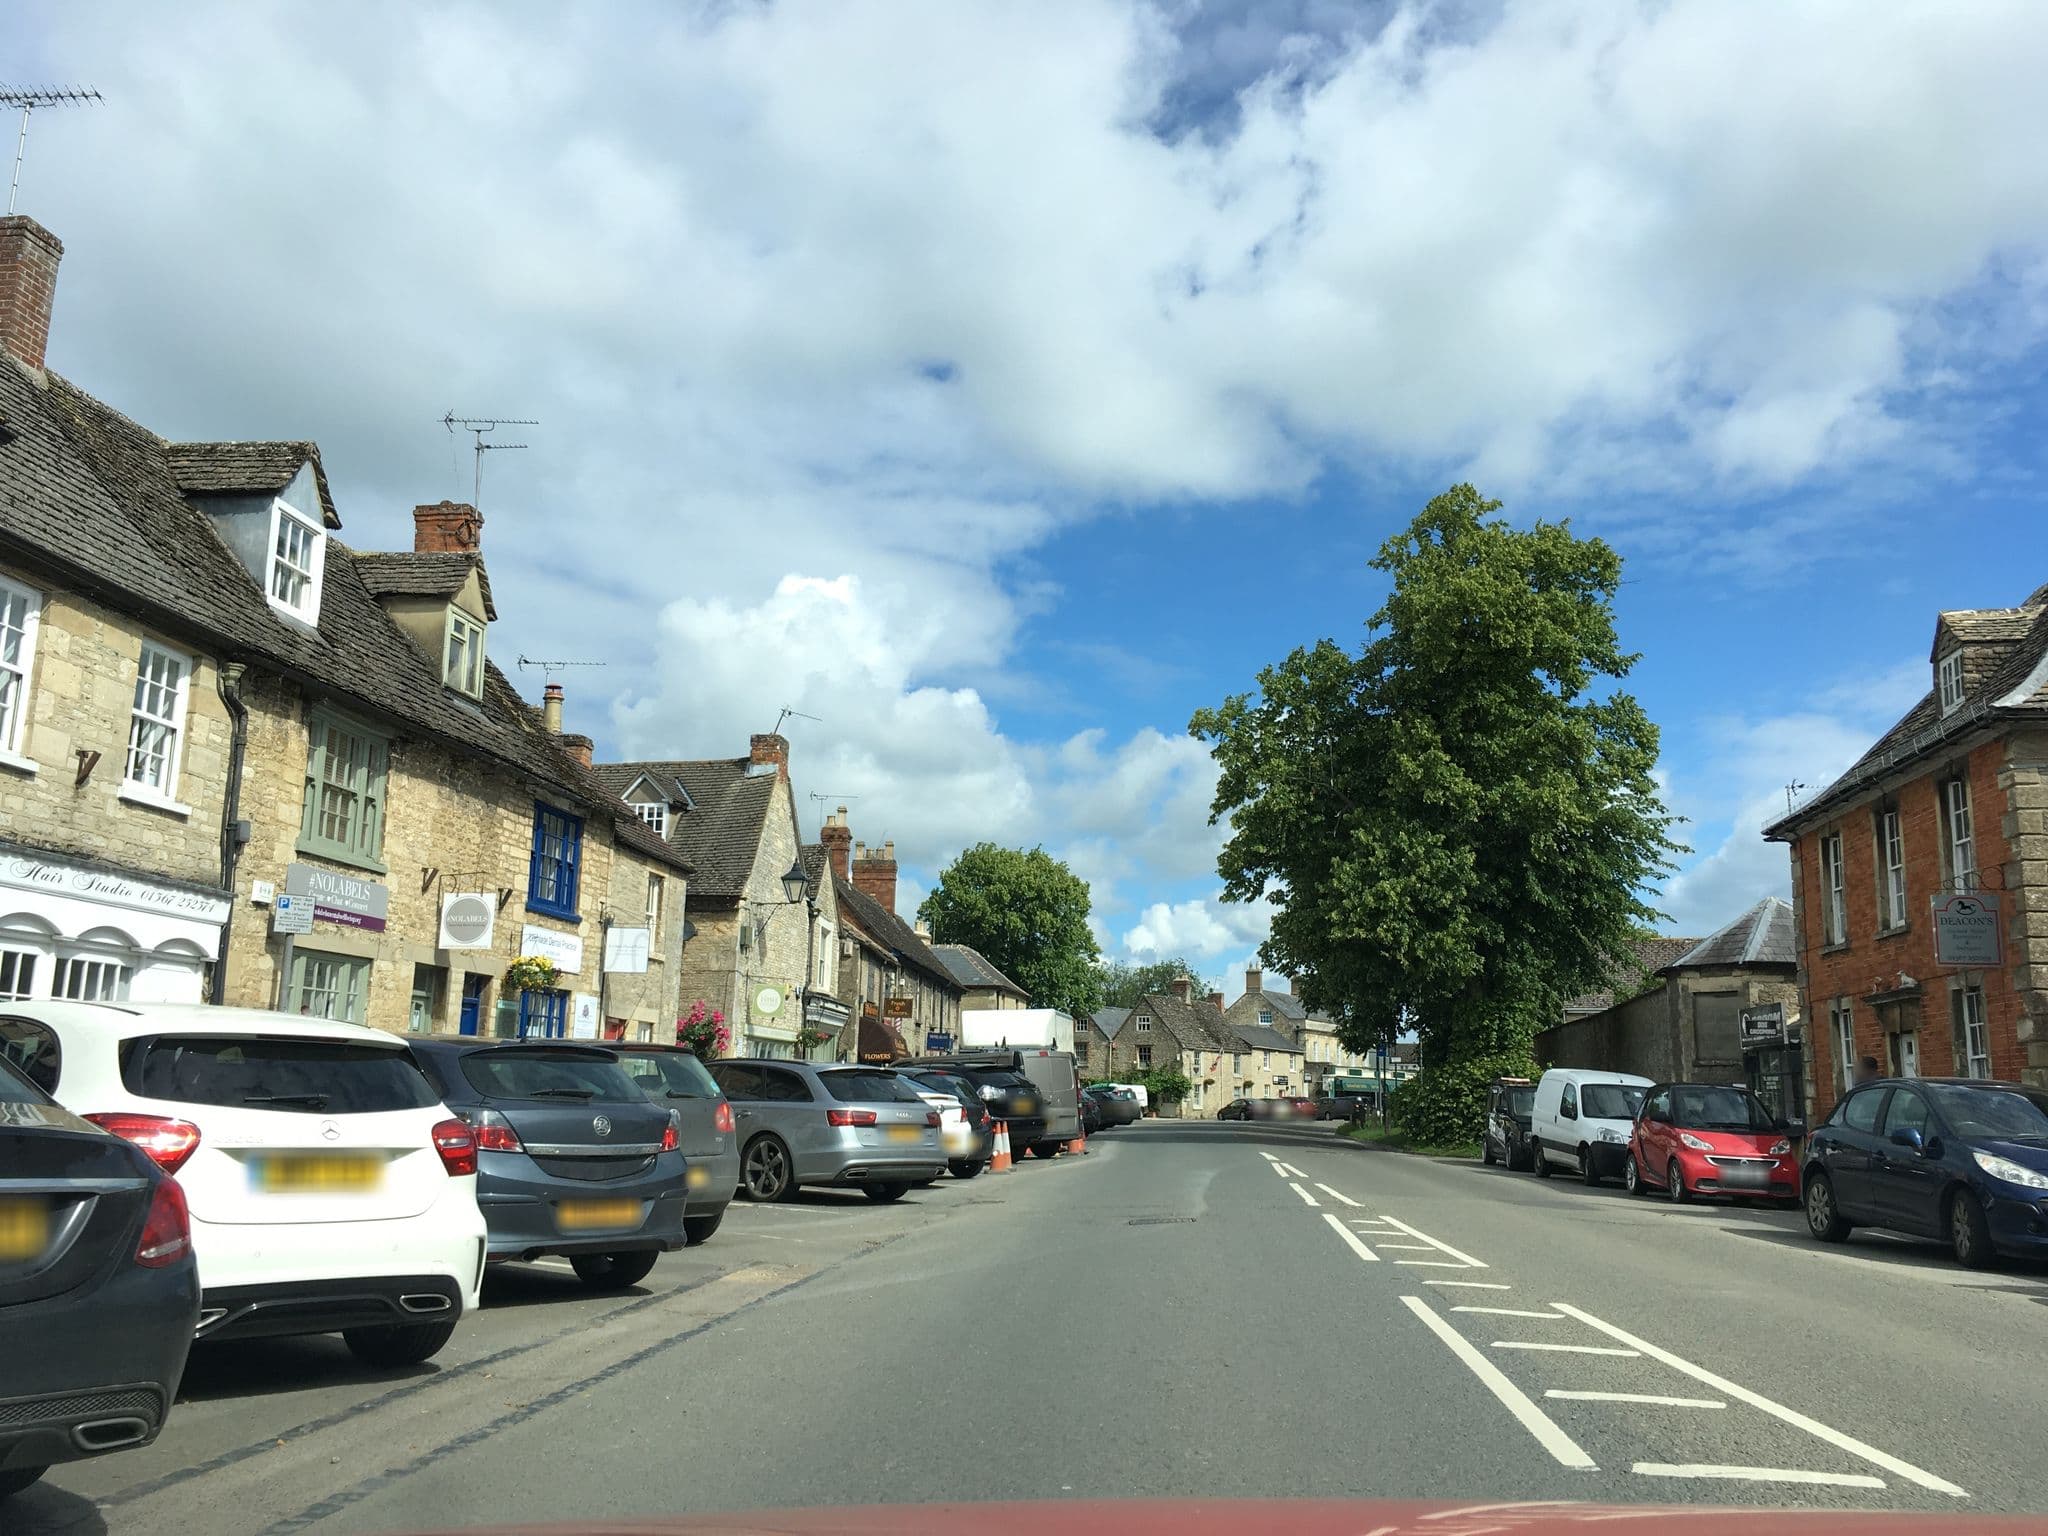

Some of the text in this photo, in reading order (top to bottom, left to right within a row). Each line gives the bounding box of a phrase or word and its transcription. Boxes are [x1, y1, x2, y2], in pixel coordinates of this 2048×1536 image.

[10, 861, 63, 883] Hair
[72, 873, 132, 896] Studio
[309, 872, 371, 901] #NOLABELS
[1940, 917, 1993, 926] DEACON'S
